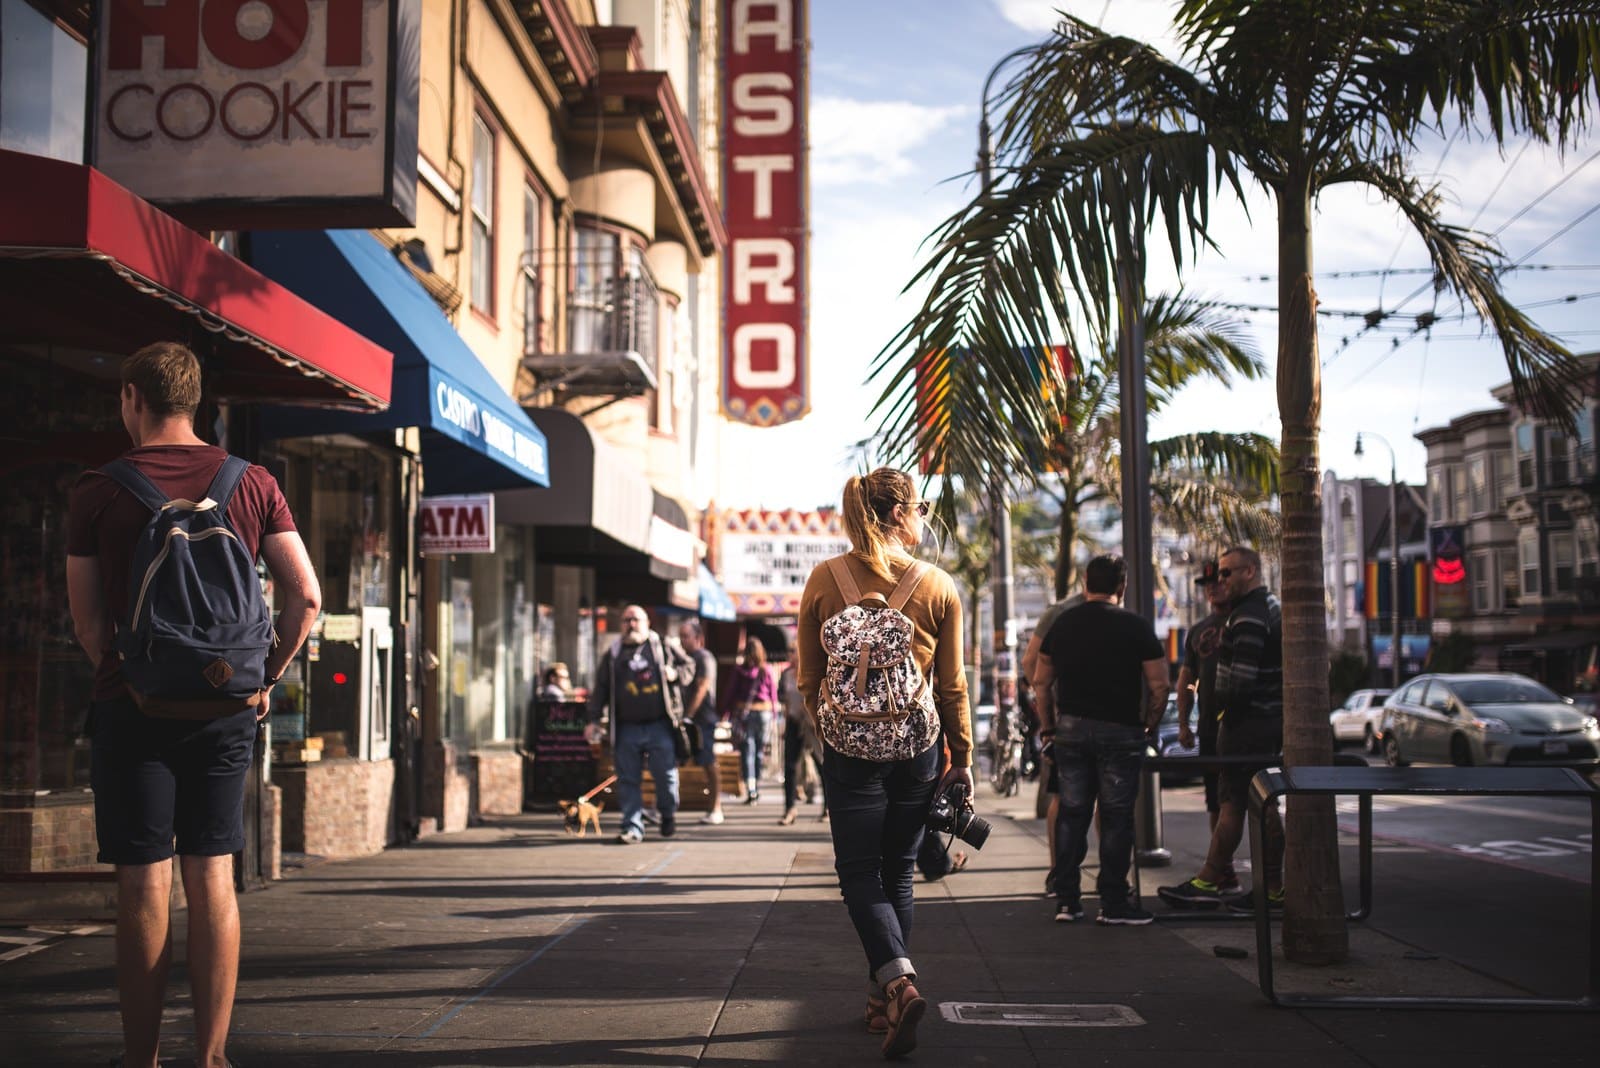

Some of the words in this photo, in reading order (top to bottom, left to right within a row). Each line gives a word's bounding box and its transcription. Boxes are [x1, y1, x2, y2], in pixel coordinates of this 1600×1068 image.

[107, 0, 376, 70] HOT
[106, 80, 373, 141] COOKIE
[436, 380, 481, 438] CASTRO
[420, 506, 486, 537] ATM
[744, 542, 774, 554] JACK
